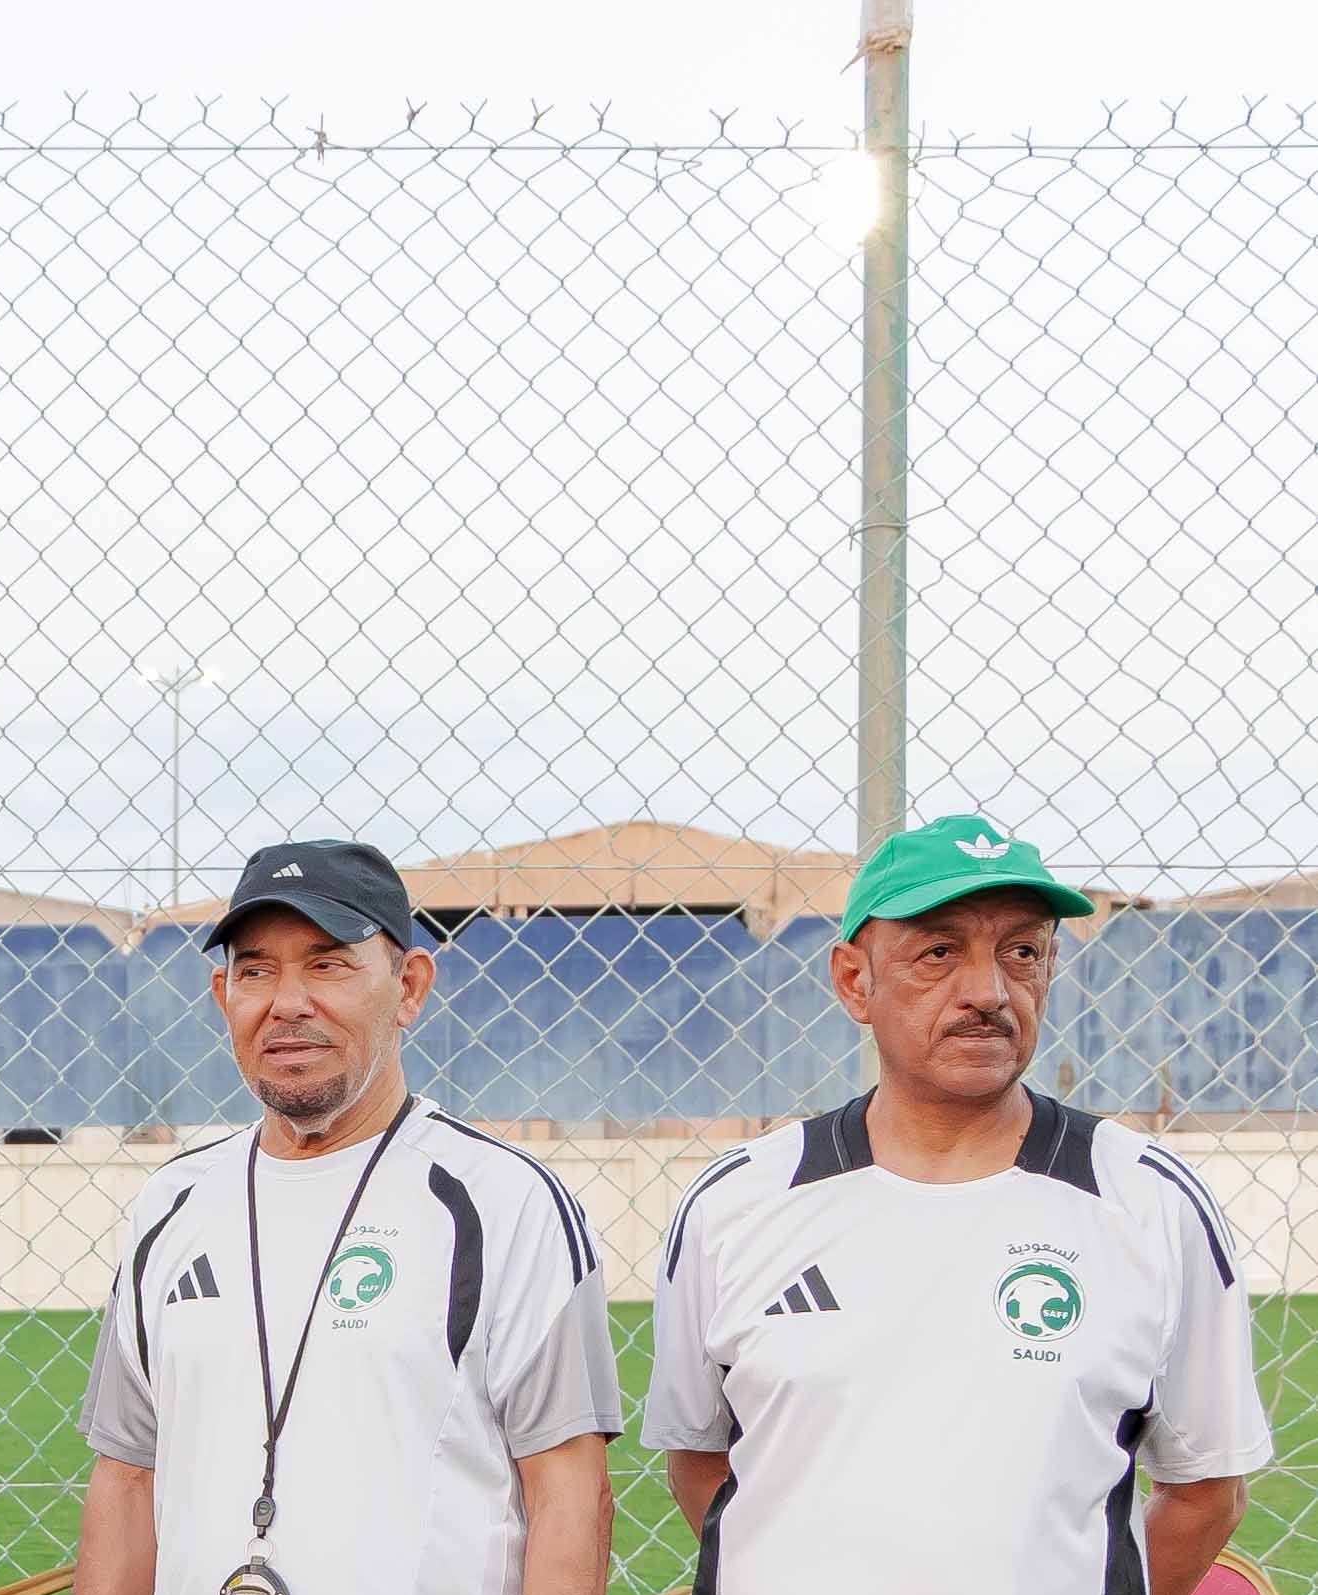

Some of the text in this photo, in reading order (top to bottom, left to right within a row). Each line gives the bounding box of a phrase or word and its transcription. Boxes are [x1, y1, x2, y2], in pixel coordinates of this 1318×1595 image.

[1006, 1242, 1080, 1263] السعودية
[1043, 1309, 1069, 1319] SAFF
[331, 1319, 369, 1330] SAUDI
[1012, 1347, 1062, 1362] SAUDI
